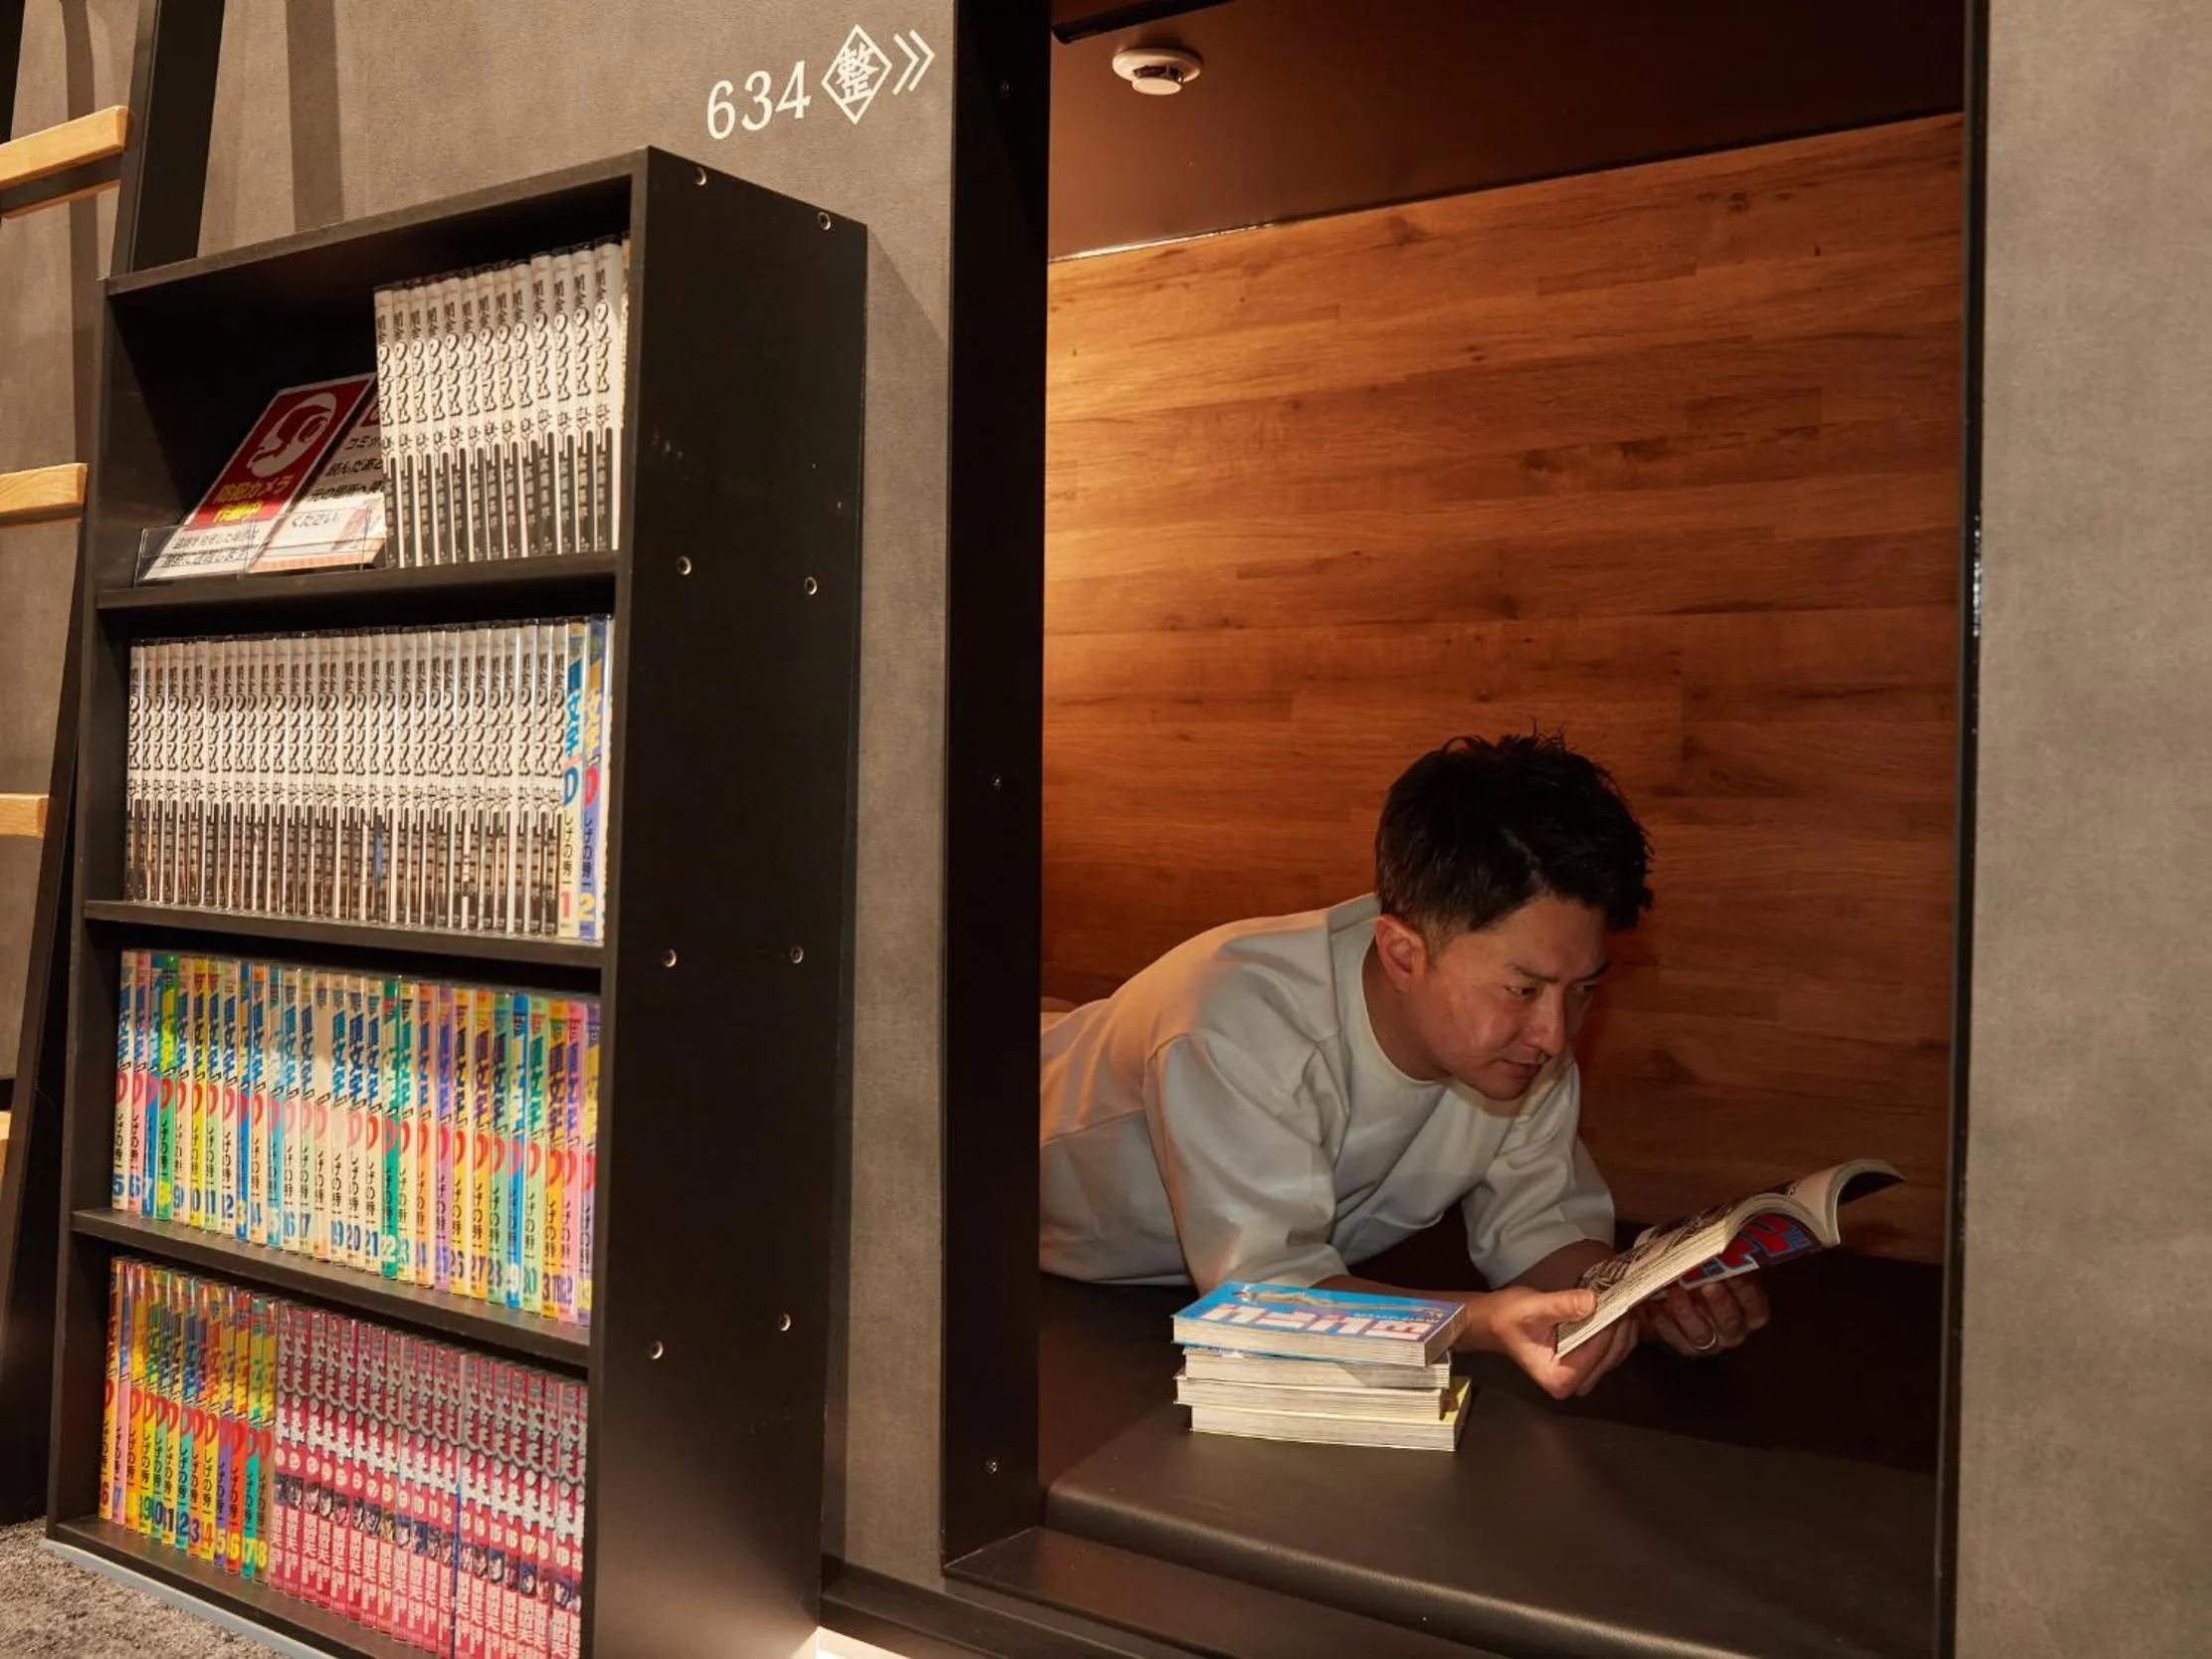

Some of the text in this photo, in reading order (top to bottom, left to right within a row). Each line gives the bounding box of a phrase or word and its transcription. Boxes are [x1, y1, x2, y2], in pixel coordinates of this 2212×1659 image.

[706, 60, 812, 140] 634
[561, 892, 572, 918] 1
[576, 892, 595, 922] 2
[112, 1174, 124, 1195] 5
[129, 1174, 140, 1197] 6
